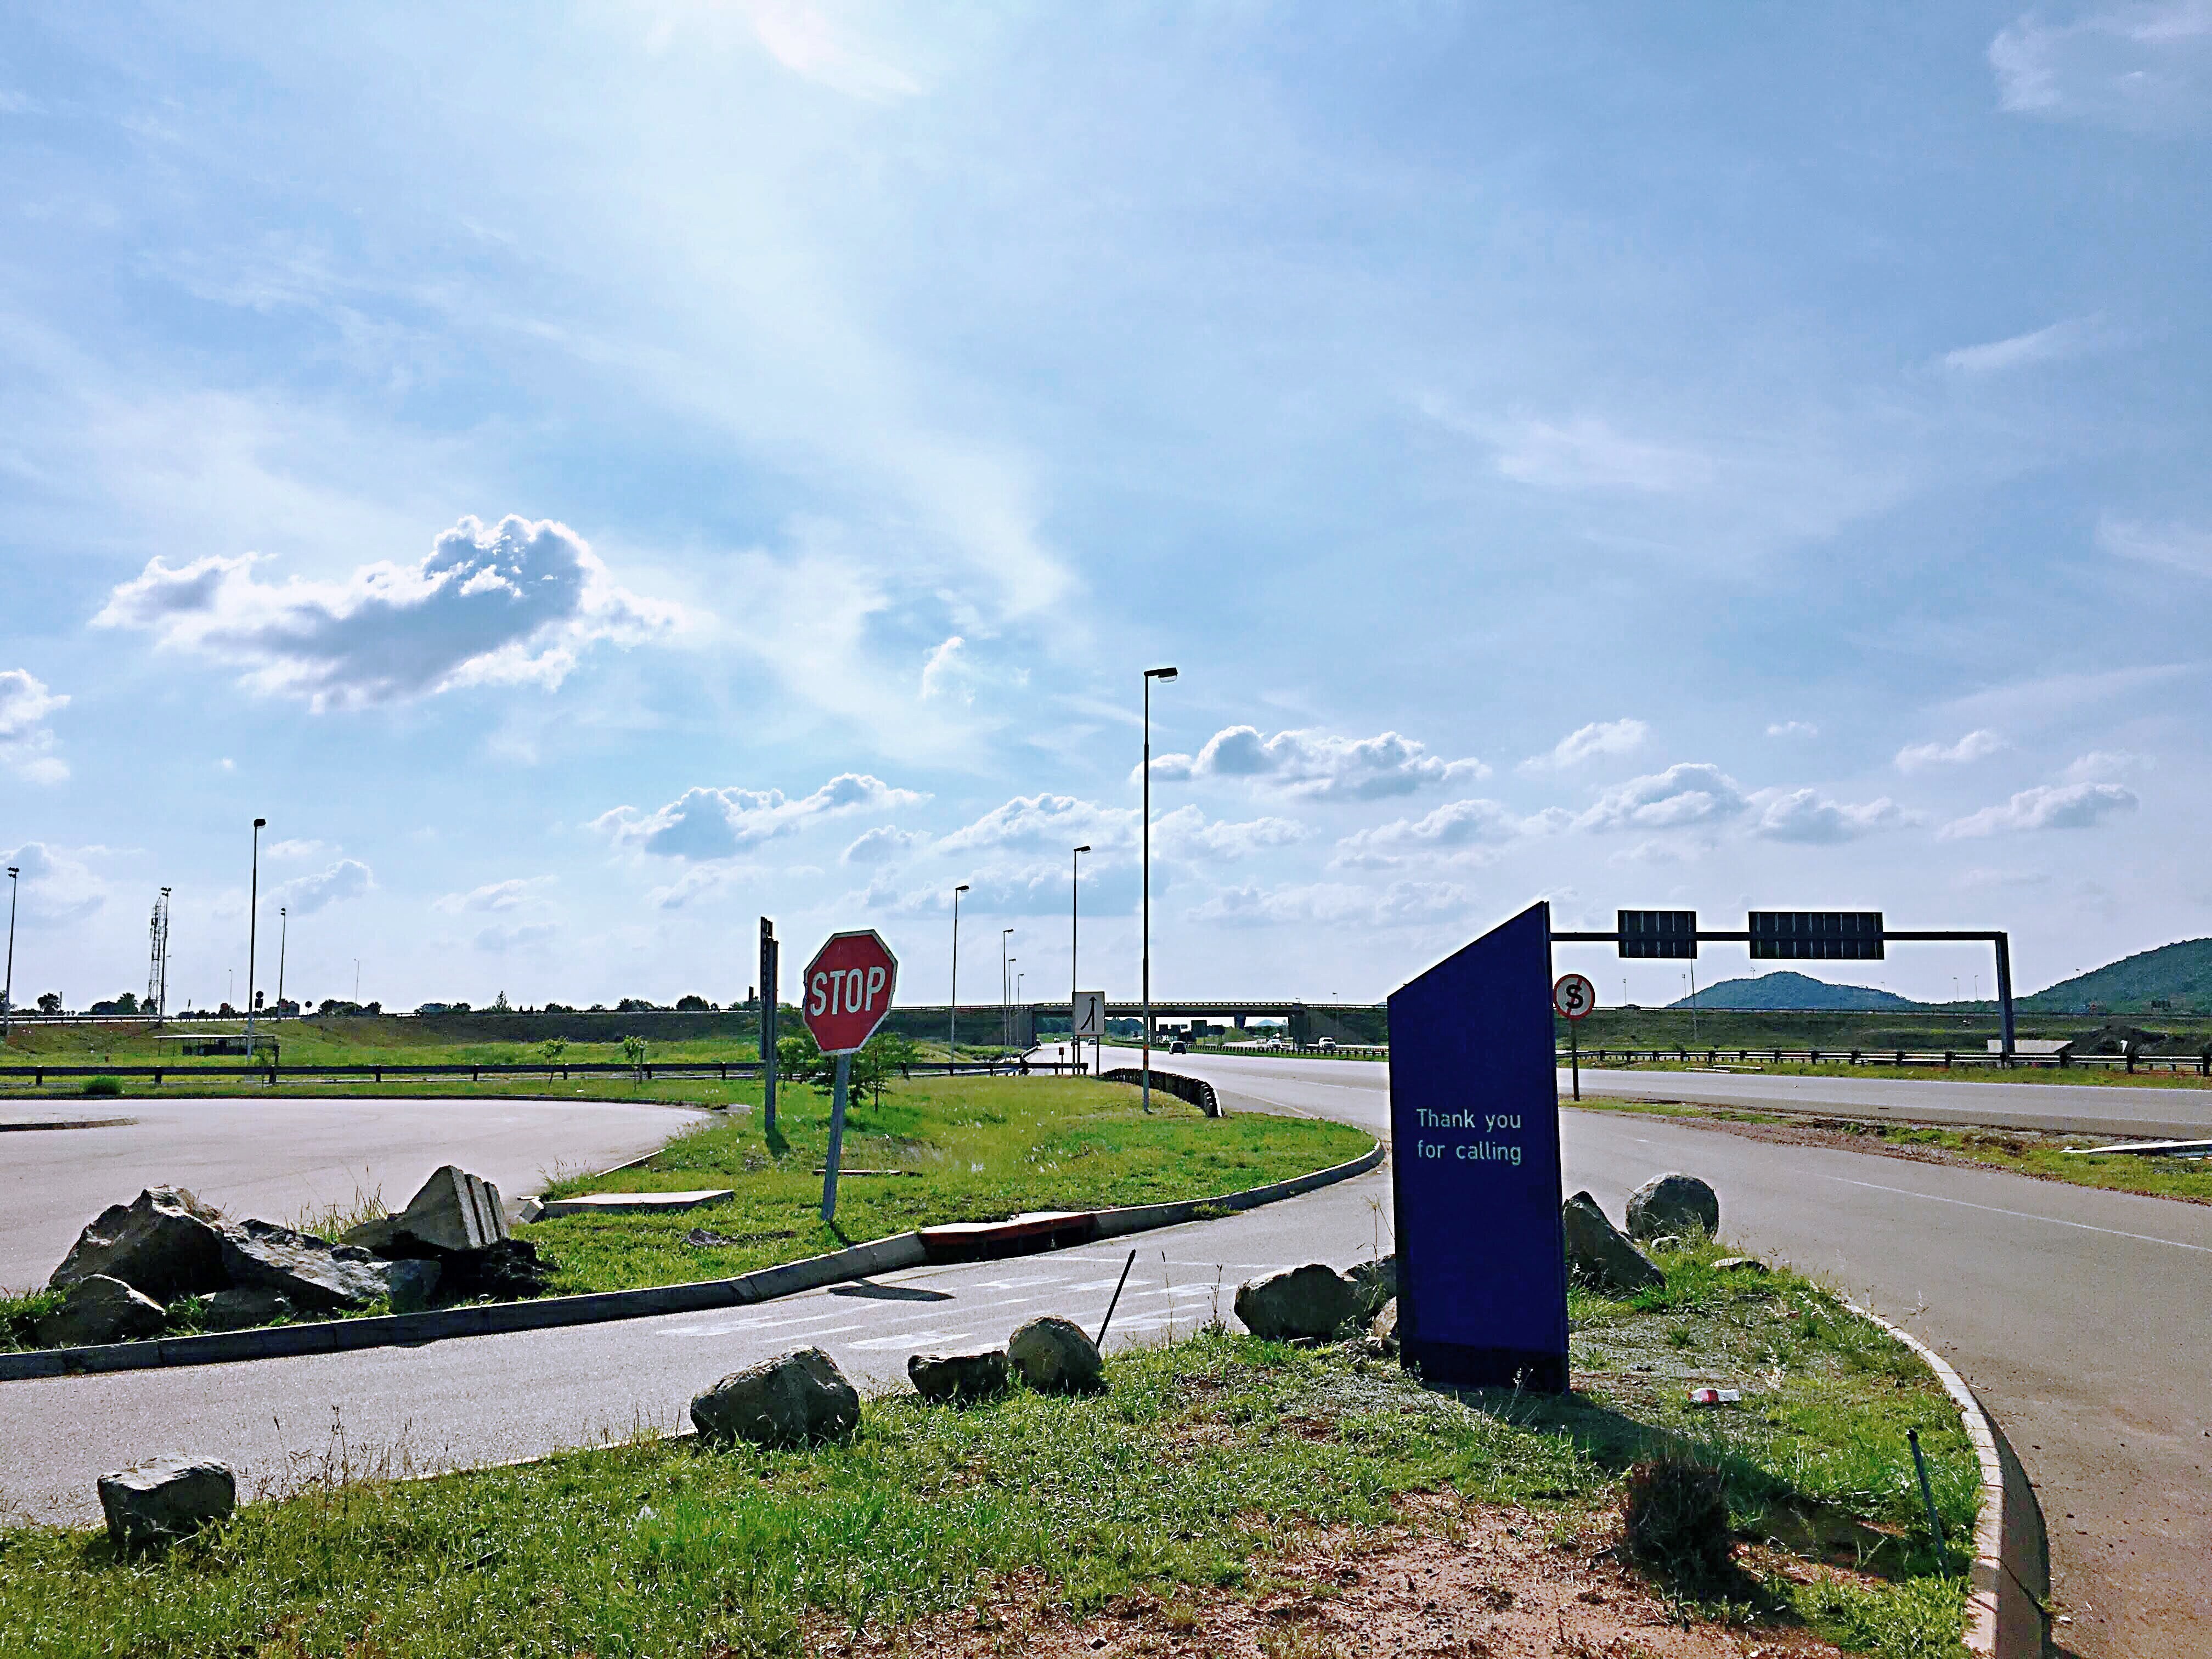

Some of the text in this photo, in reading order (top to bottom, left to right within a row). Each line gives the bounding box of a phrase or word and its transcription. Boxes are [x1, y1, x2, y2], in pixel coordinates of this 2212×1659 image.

[810, 966, 886, 1017] STOP
[1416, 1108, 1521, 1133] Thank you
[1418, 1140, 1521, 1166] for calling
